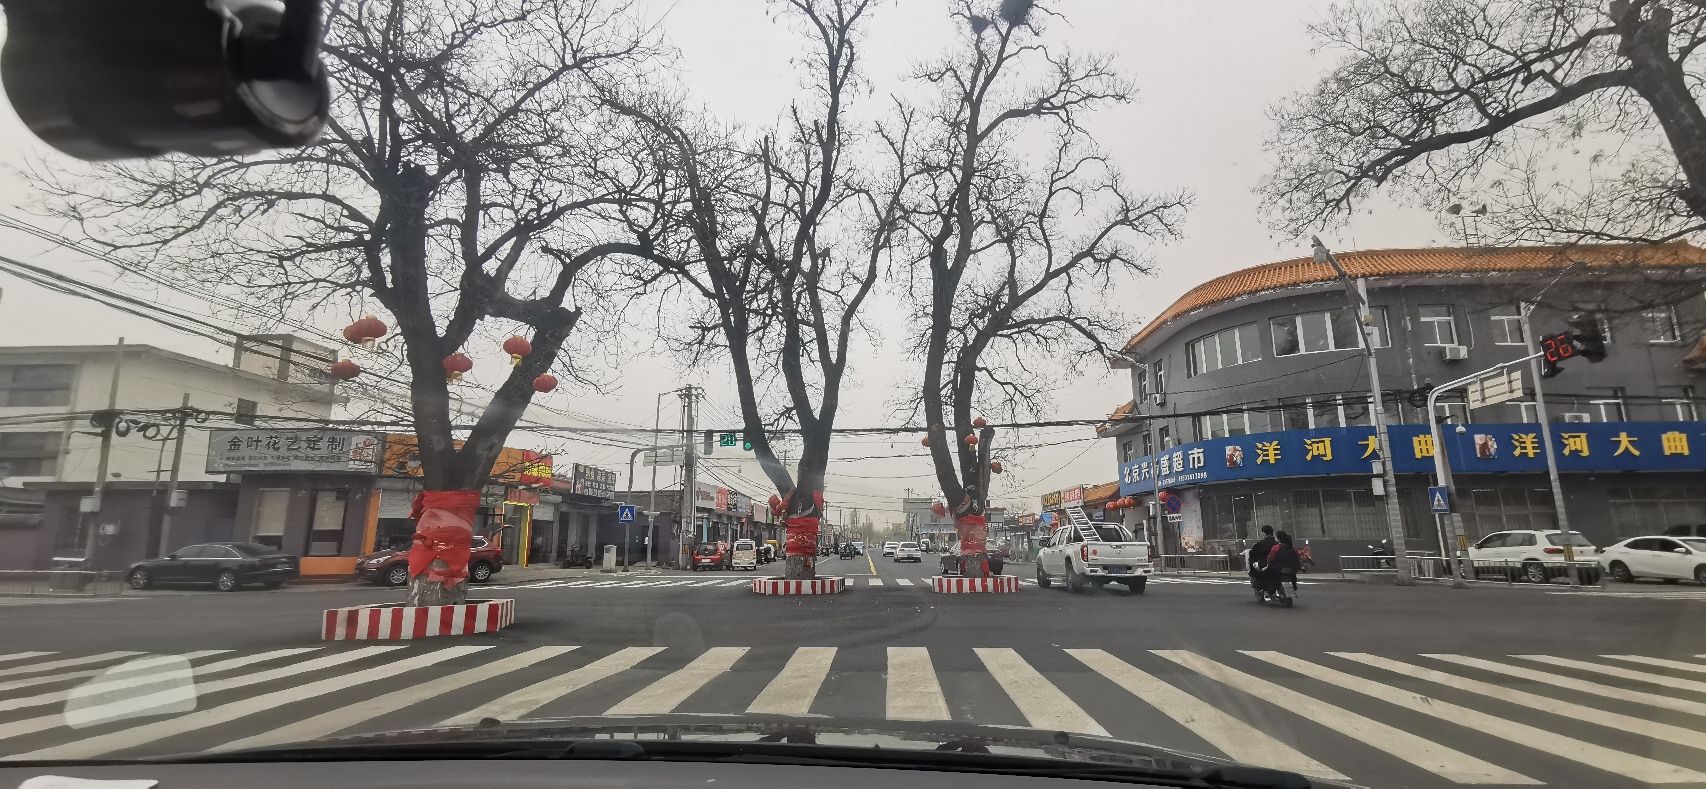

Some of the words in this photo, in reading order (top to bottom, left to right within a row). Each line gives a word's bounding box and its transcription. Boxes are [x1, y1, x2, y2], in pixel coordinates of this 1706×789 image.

[1544, 335, 1574, 362] 26
[227, 434, 346, 452] 金叶花艺定制
[1256, 436, 1436, 465] 洋河大曲
[1511, 431, 1690, 458] 洋河大曲
